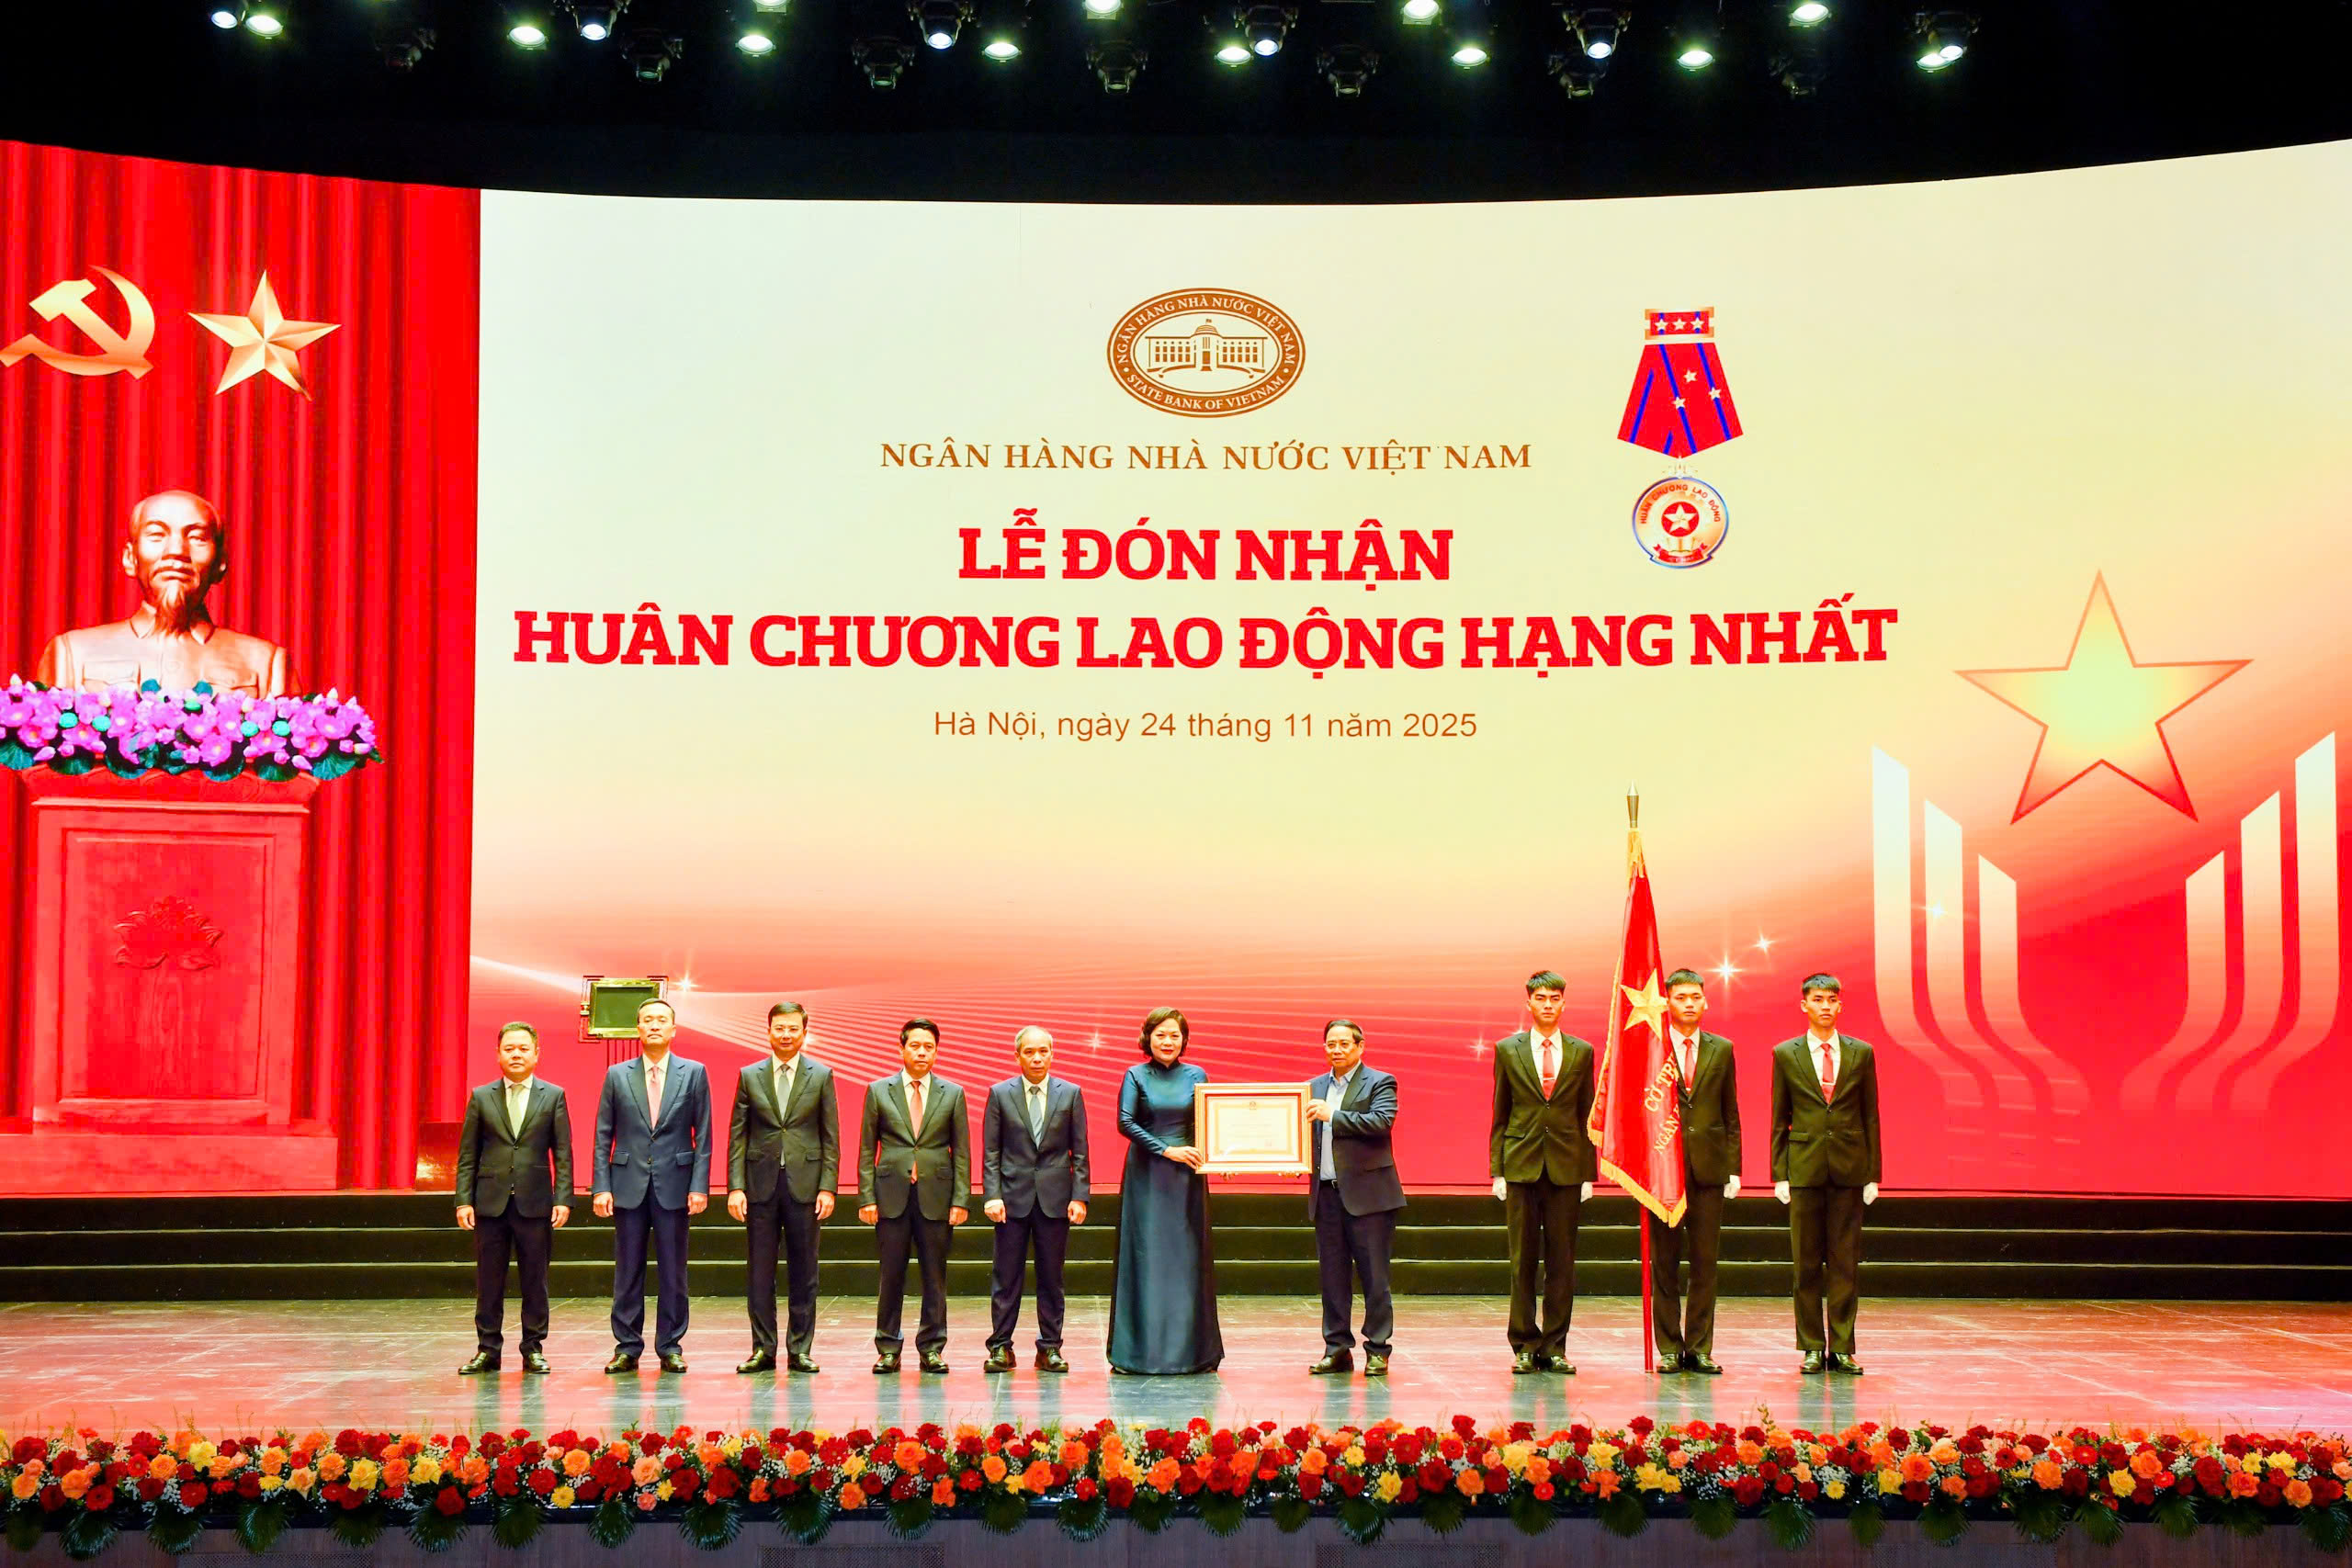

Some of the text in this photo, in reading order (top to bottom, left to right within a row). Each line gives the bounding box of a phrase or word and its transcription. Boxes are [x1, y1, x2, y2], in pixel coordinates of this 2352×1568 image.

[1117, 295, 1296, 365] NGÂN HÀNG NHÀ NƯỚC VIỆT NAM
[1126, 373, 1285, 410] STATE BANK OF VIETNAM
[881, 437, 1532, 475] NGÂN HÀNG NHÀ NƯỚC VIỆT NAM
[1691, 486, 1709, 499] LAO
[959, 508, 1453, 591] LỄ ĐÓN NHẬN
[514, 592, 1898, 679] HUÂN CHƯƠNG LAO ĐỘNG HẠNG NHẤT
[935, 712, 1477, 742] Hà Nội, ngày 24 tháng 11 năm 2025
[1644, 1084, 1664, 1112] CỜ
